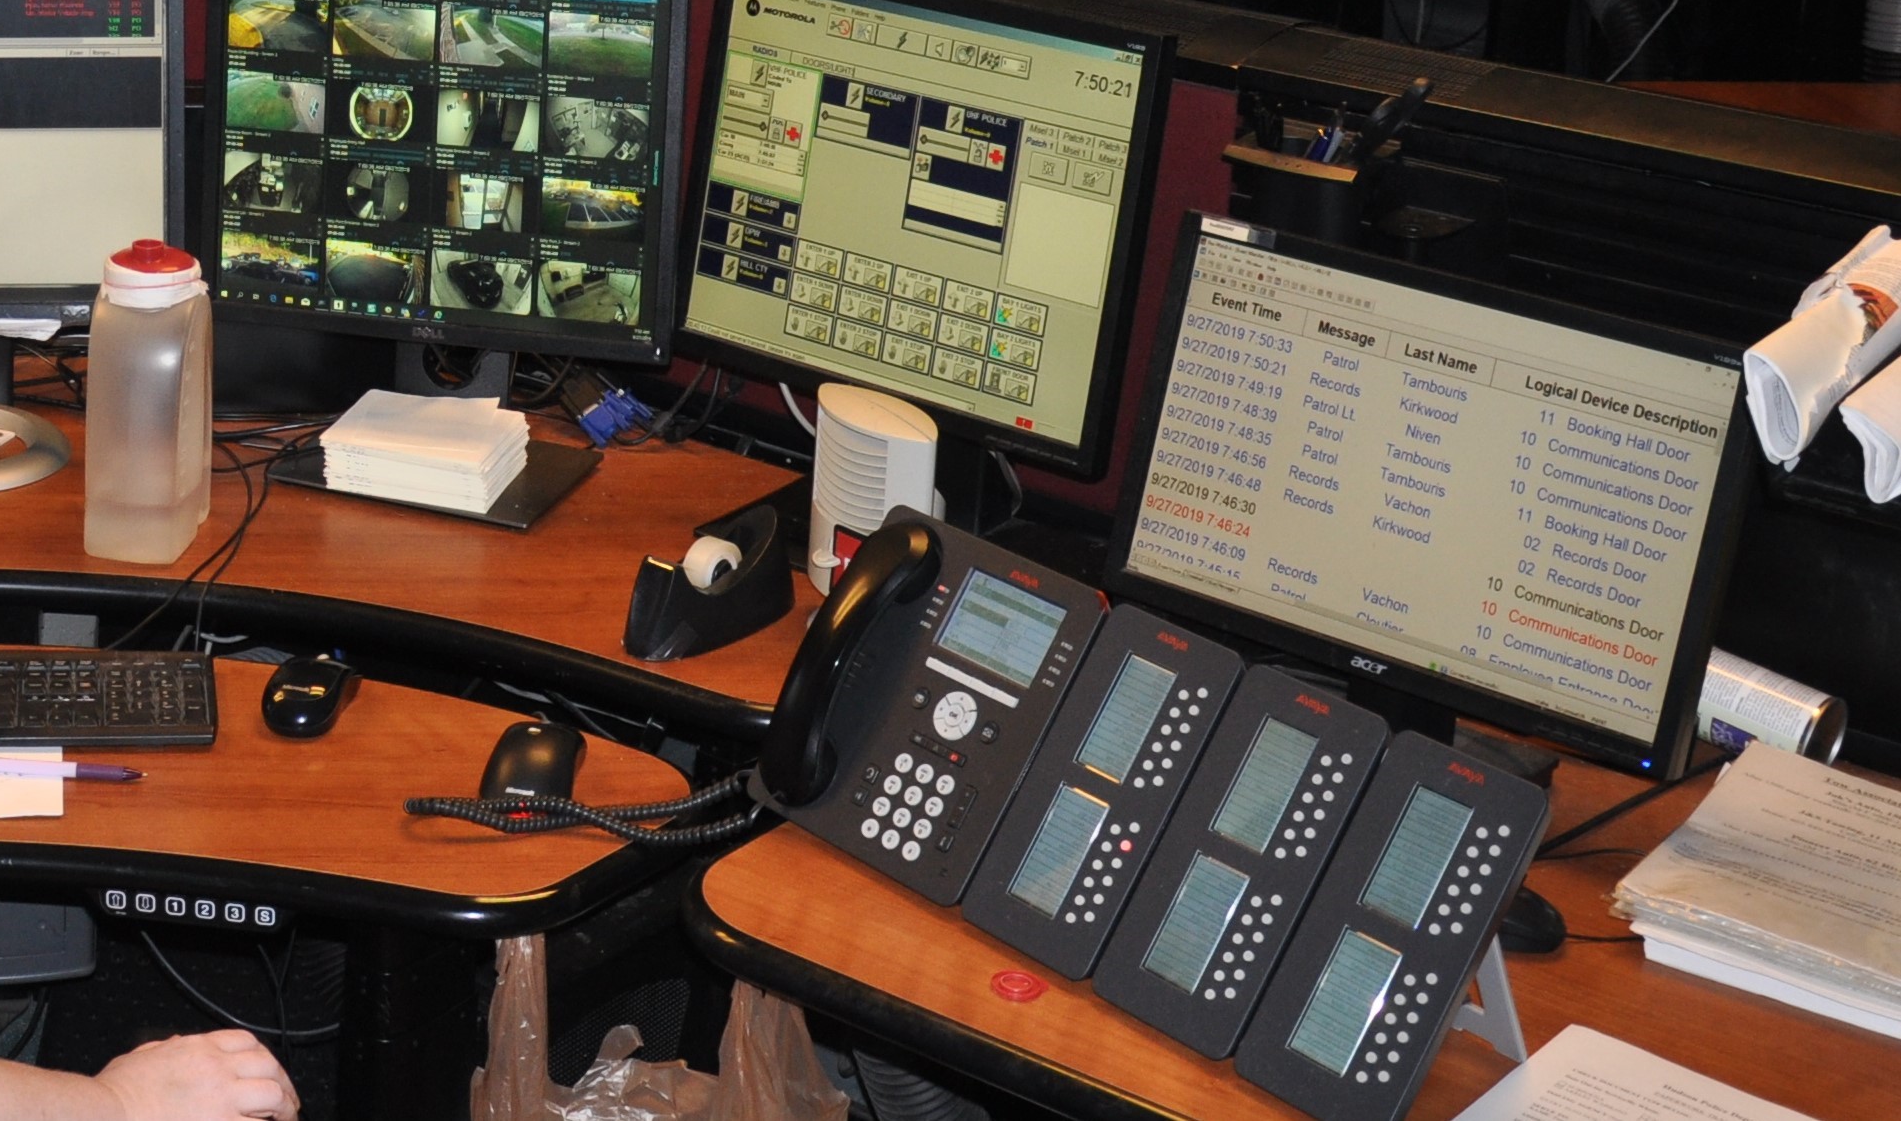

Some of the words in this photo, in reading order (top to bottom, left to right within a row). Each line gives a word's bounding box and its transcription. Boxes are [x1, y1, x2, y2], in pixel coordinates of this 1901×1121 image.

[763, 7, 816, 23] MOTOROLA
[752, 46, 778, 56] RADIOS
[783, 68, 807, 79] POLICE
[1073, 72, 1133, 97] 7:50:21
[866, 88, 906, 102] SECONDARY
[982, 114, 1007, 127] POLICE
[1026, 137, 1048, 148] Patch
[1063, 145, 1081, 156] Msel
[1099, 154, 1117, 164] Msel
[1063, 132, 1084, 144] Patch
[1099, 141, 1120, 152] Patch
[755, 264, 768, 274] CTY
[1212, 292, 1247, 312] Event
[1252, 302, 1282, 322] Time
[1318, 320, 1375, 348] Message
[1404, 343, 1434, 362] Last
[1437, 352, 1477, 374] Name
[1525, 375, 1578, 400] Logical
[1581, 390, 1629, 414] Device
[1633, 404, 1718, 438] Description
[1187, 314, 1245, 340] 9/27/2019
[1248, 330, 1292, 353] 7:50:33
[1323, 350, 1359, 371] Patrol
[1402, 371, 1467, 402] Tambouris
[1541, 410, 1554, 425] 11
[1567, 417, 1622, 446] Booking
[1626, 433, 1653, 451] Hall
[1655, 441, 1691, 462] Door
[1182, 336, 1240, 363] 9/27/2019
[1243, 353, 1286, 376] 7:50:21
[1310, 372, 1360, 397] Records
[1400, 397, 1458, 424] Kirkwood
[1522, 431, 1537, 446] 10
[1548, 438, 1660, 481] Communications
[1664, 470, 1699, 491] Door
[1177, 359, 1235, 386] 9/27/2019
[1238, 376, 1282, 400] 7:49:19
[1303, 394, 1339, 415] Patrol
[1405, 424, 1441, 445] Niven
[1516, 455, 1531, 470] 10
[1543, 463, 1654, 506] Communications
[1658, 495, 1693, 516] Door
[1162, 427, 1219, 455] 9/27/2019
[1223, 445, 1266, 469] 7:46:56
[1289, 464, 1339, 491] Records
[1385, 493, 1430, 519] Vachon
[1523, 535, 1541, 552] 02
[1552, 543, 1608, 572] Records
[1613, 562, 1647, 583] Door
[1146, 494, 1204, 523] 9/27/2019
[1207, 513, 1250, 537] 7:46:24
[1482, 600, 1497, 616] 10
[1509, 609, 1619, 655] Communications
[1623, 644, 1658, 667] Door
[1350, 655, 1388, 676] acer
[1448, 761, 1485, 786] AVAYA
[172, 902, 178, 912] 1
[201, 904, 210, 916] 2
[230, 908, 239, 919] 3
[260, 912, 269, 922] S
